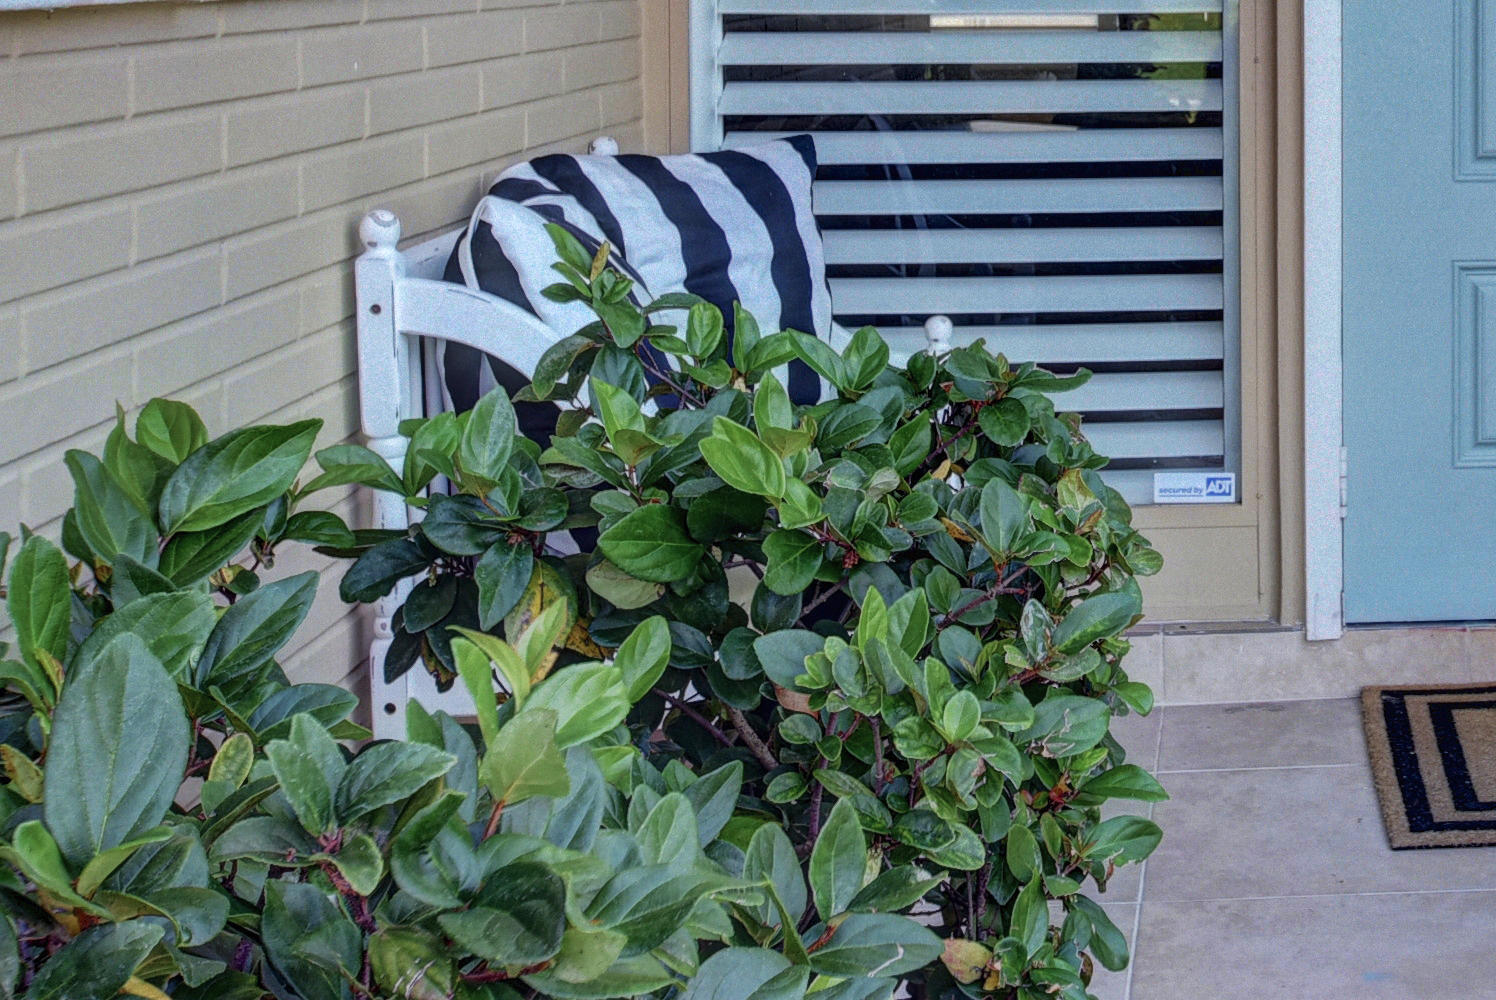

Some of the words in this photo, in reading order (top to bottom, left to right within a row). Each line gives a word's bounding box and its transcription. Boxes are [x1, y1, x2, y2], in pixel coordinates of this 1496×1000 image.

[1159, 486, 1193, 494] secured
[1193, 486, 1203, 495] by
[1206, 479, 1232, 495] ADT
